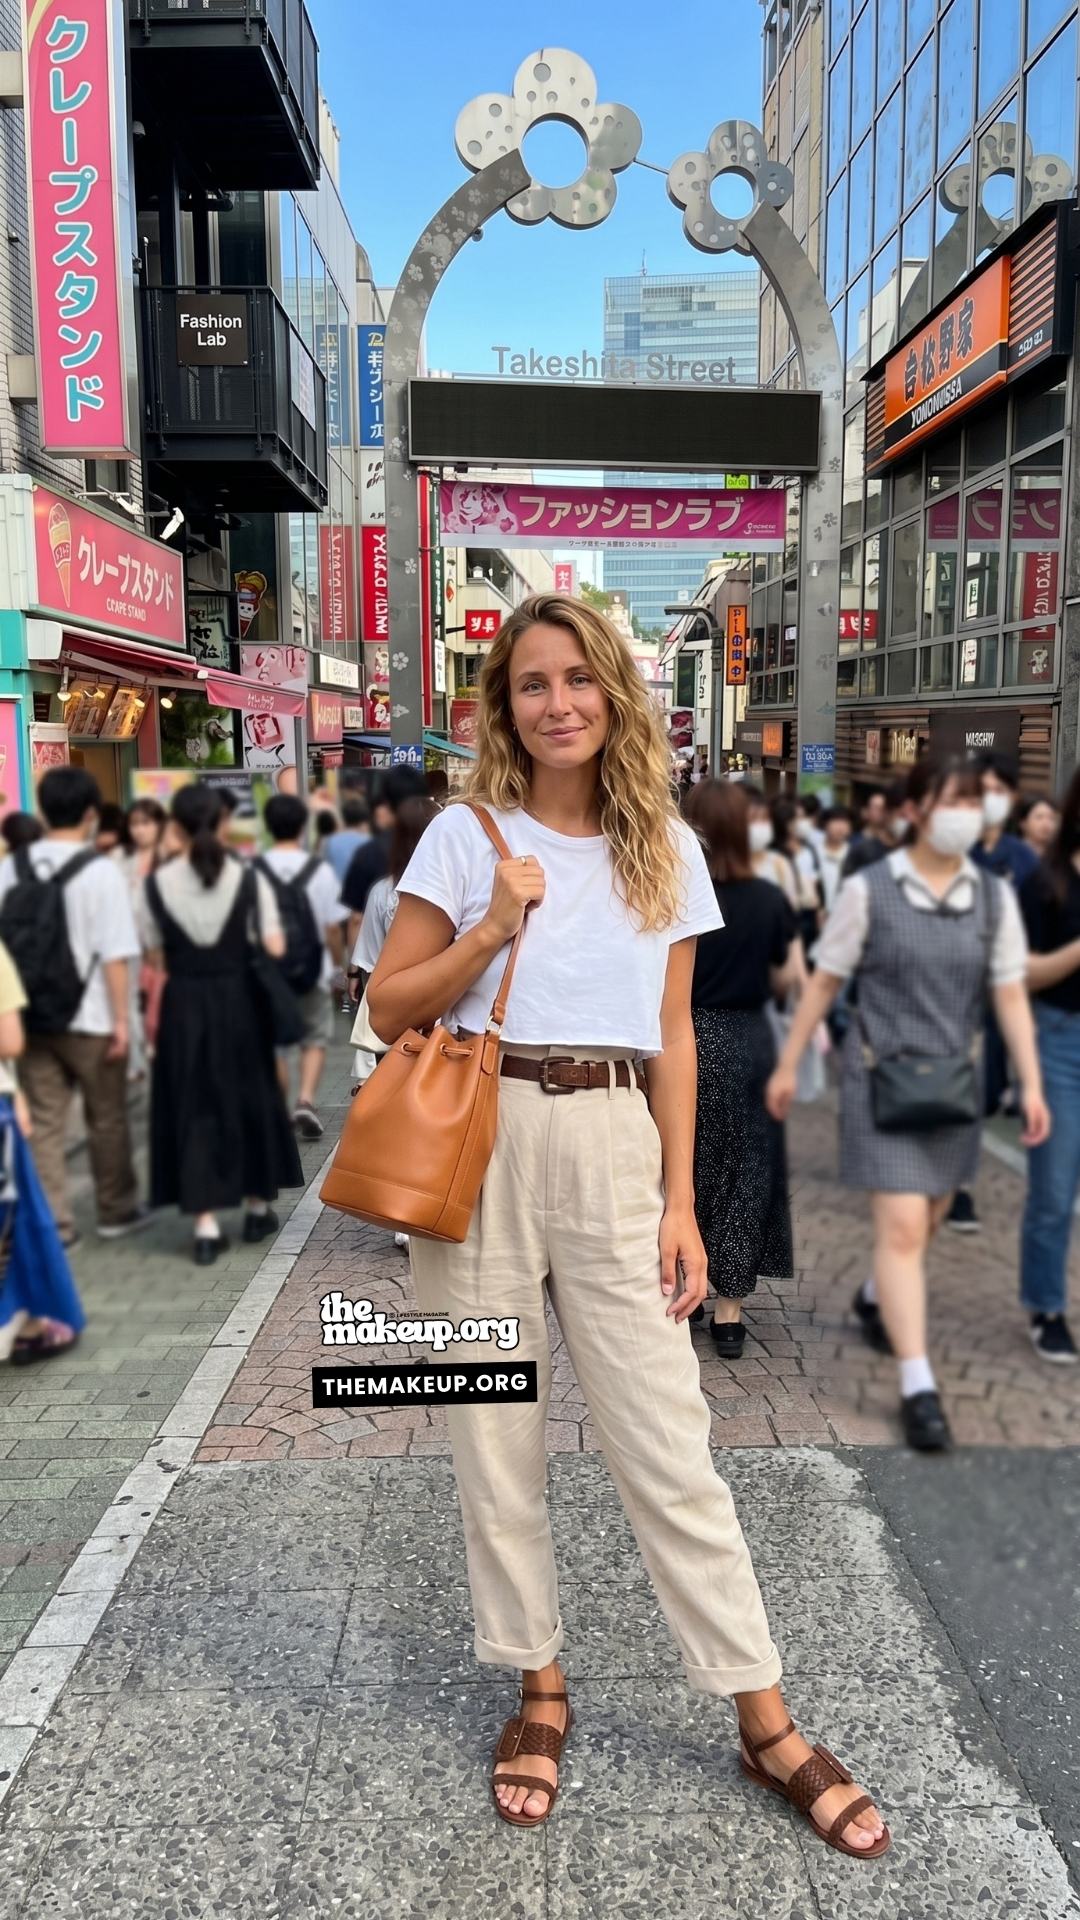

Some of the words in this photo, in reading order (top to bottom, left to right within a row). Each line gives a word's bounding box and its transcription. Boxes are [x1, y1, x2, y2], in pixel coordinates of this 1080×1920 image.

[46, 16, 104, 422] クレープスタンド
[180, 314, 242, 328] Fashion
[197, 332, 227, 346] Lab
[491, 346, 637, 379] Takeshita
[647, 352, 737, 384] Street
[519, 496, 745, 531] ファッションラブ
